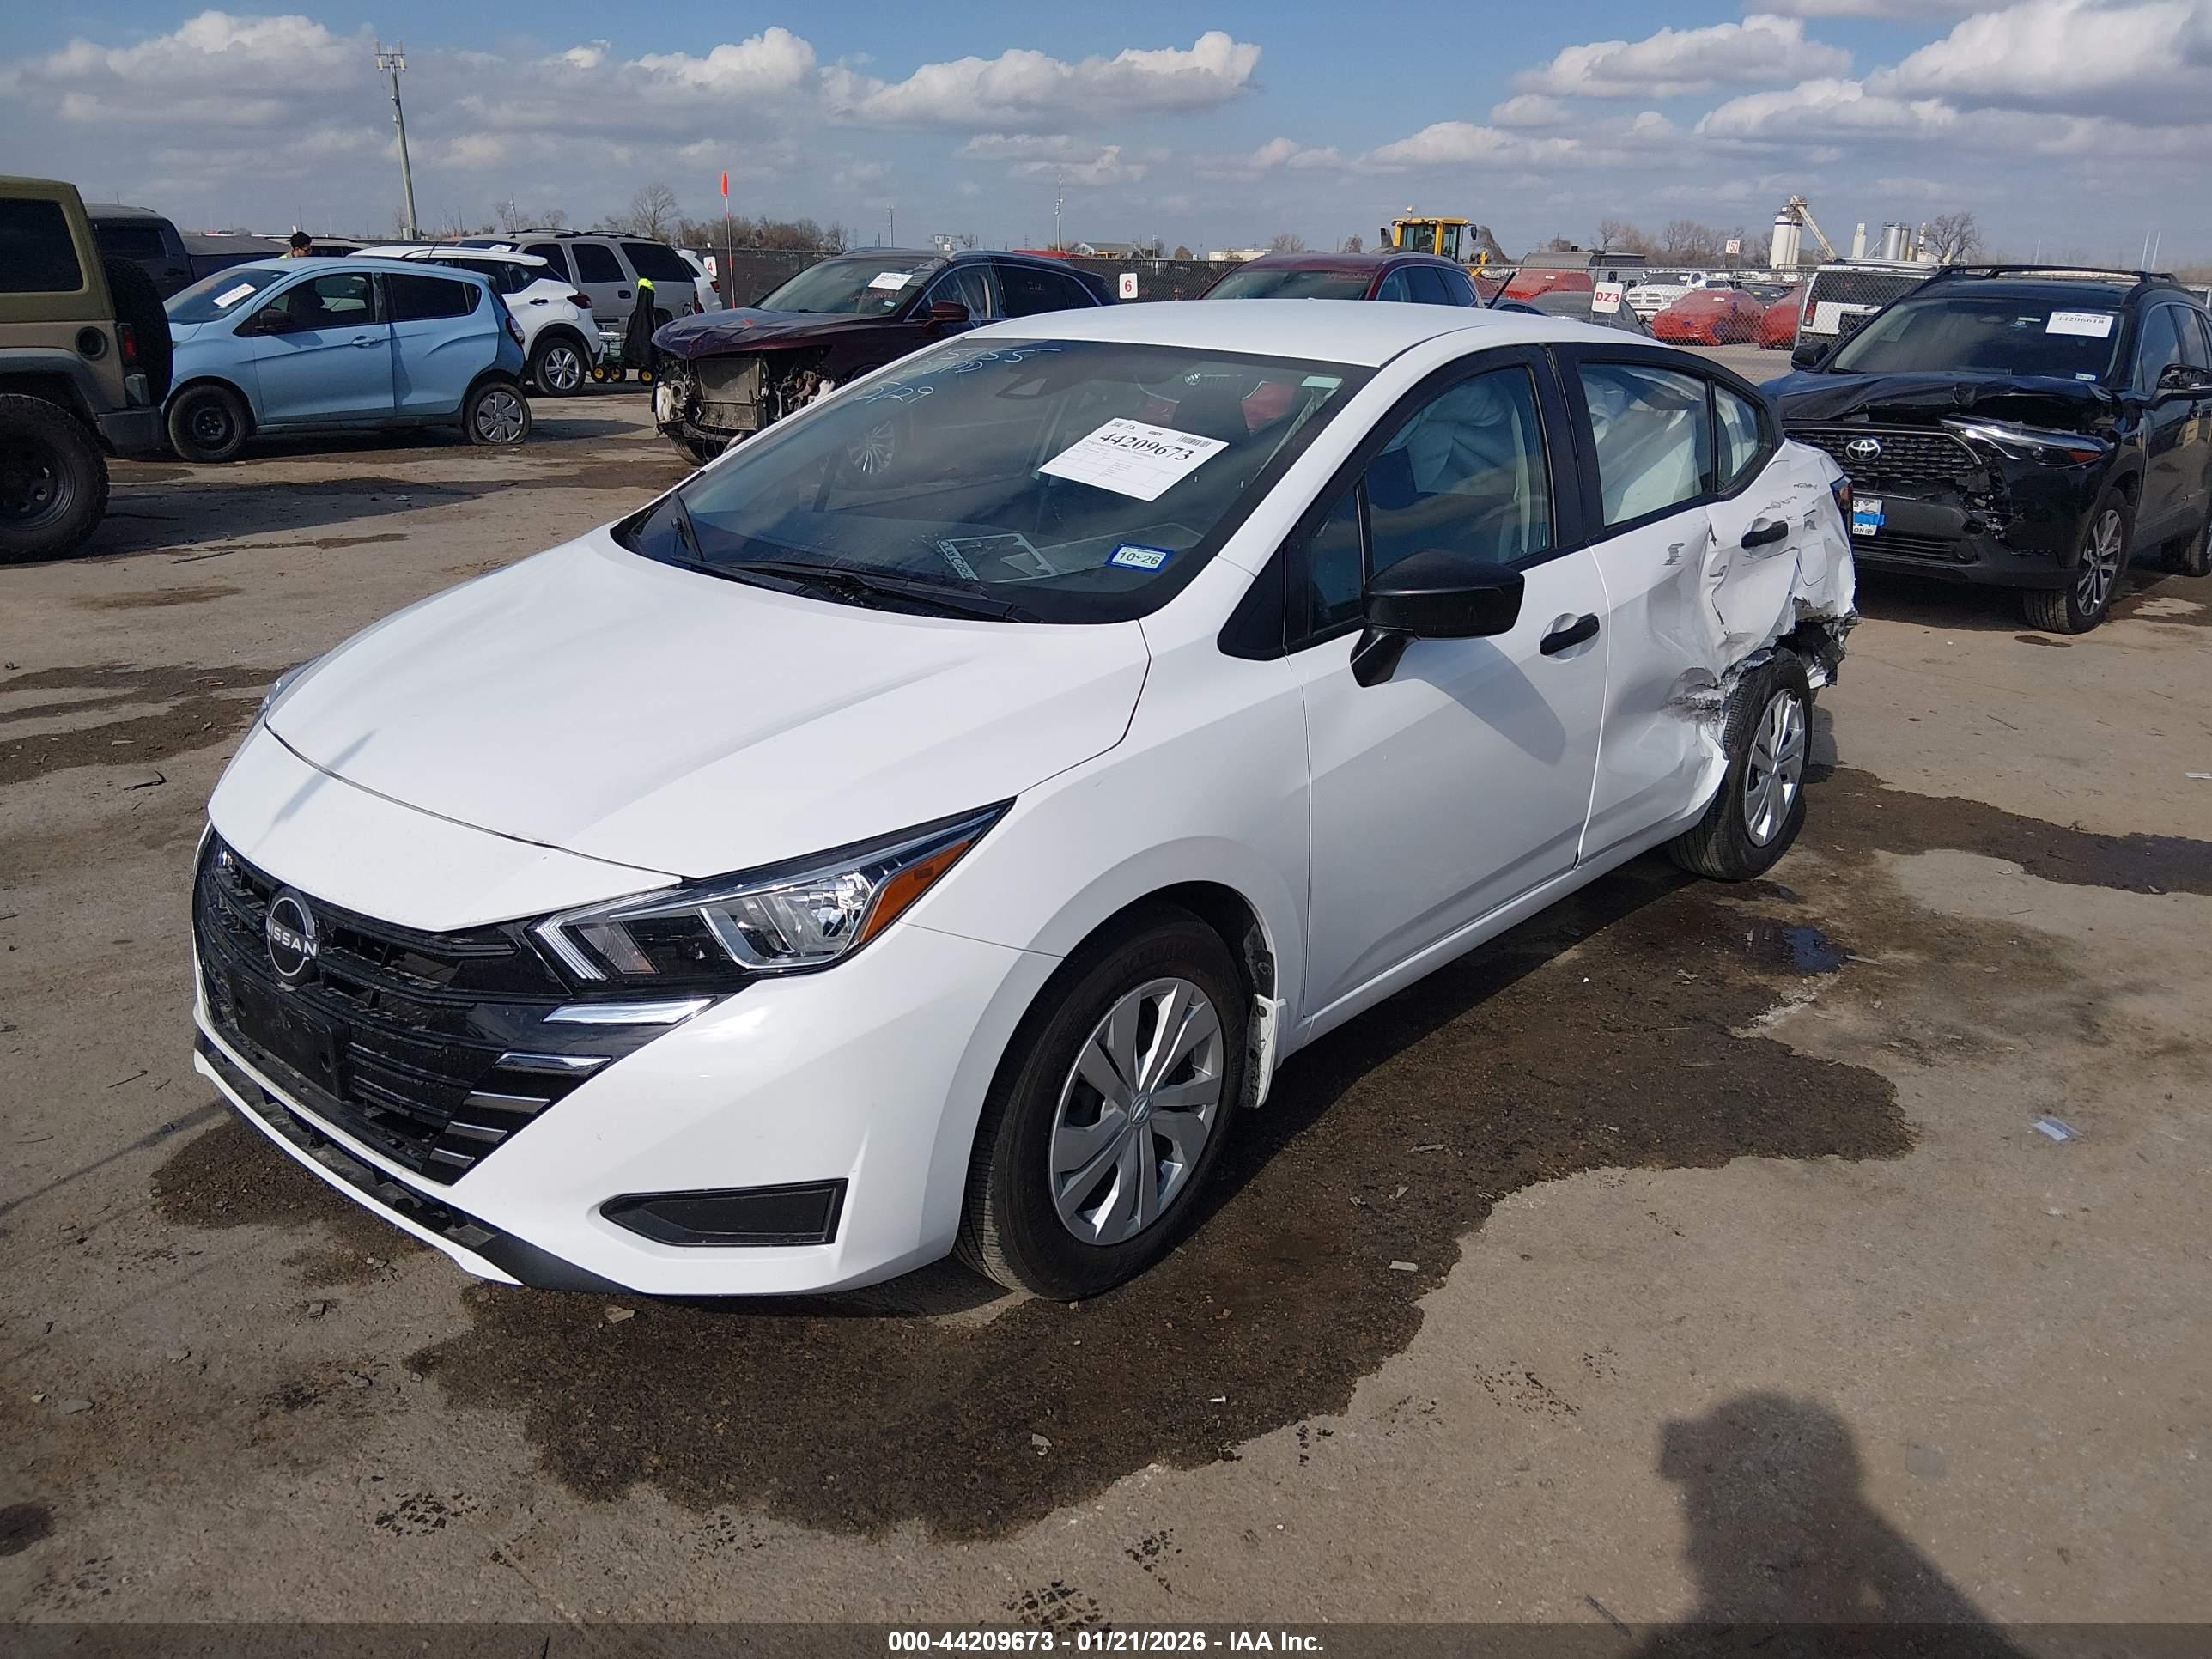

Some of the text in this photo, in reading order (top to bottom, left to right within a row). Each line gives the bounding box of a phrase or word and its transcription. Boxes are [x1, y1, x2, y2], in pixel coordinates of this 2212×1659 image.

[1728, 241, 1739, 252] 150
[708, 261, 714, 271] 4
[1124, 279, 1133, 293] 6
[1595, 292, 1620, 303] DZ3
[1099, 432, 1194, 461] 44209673
